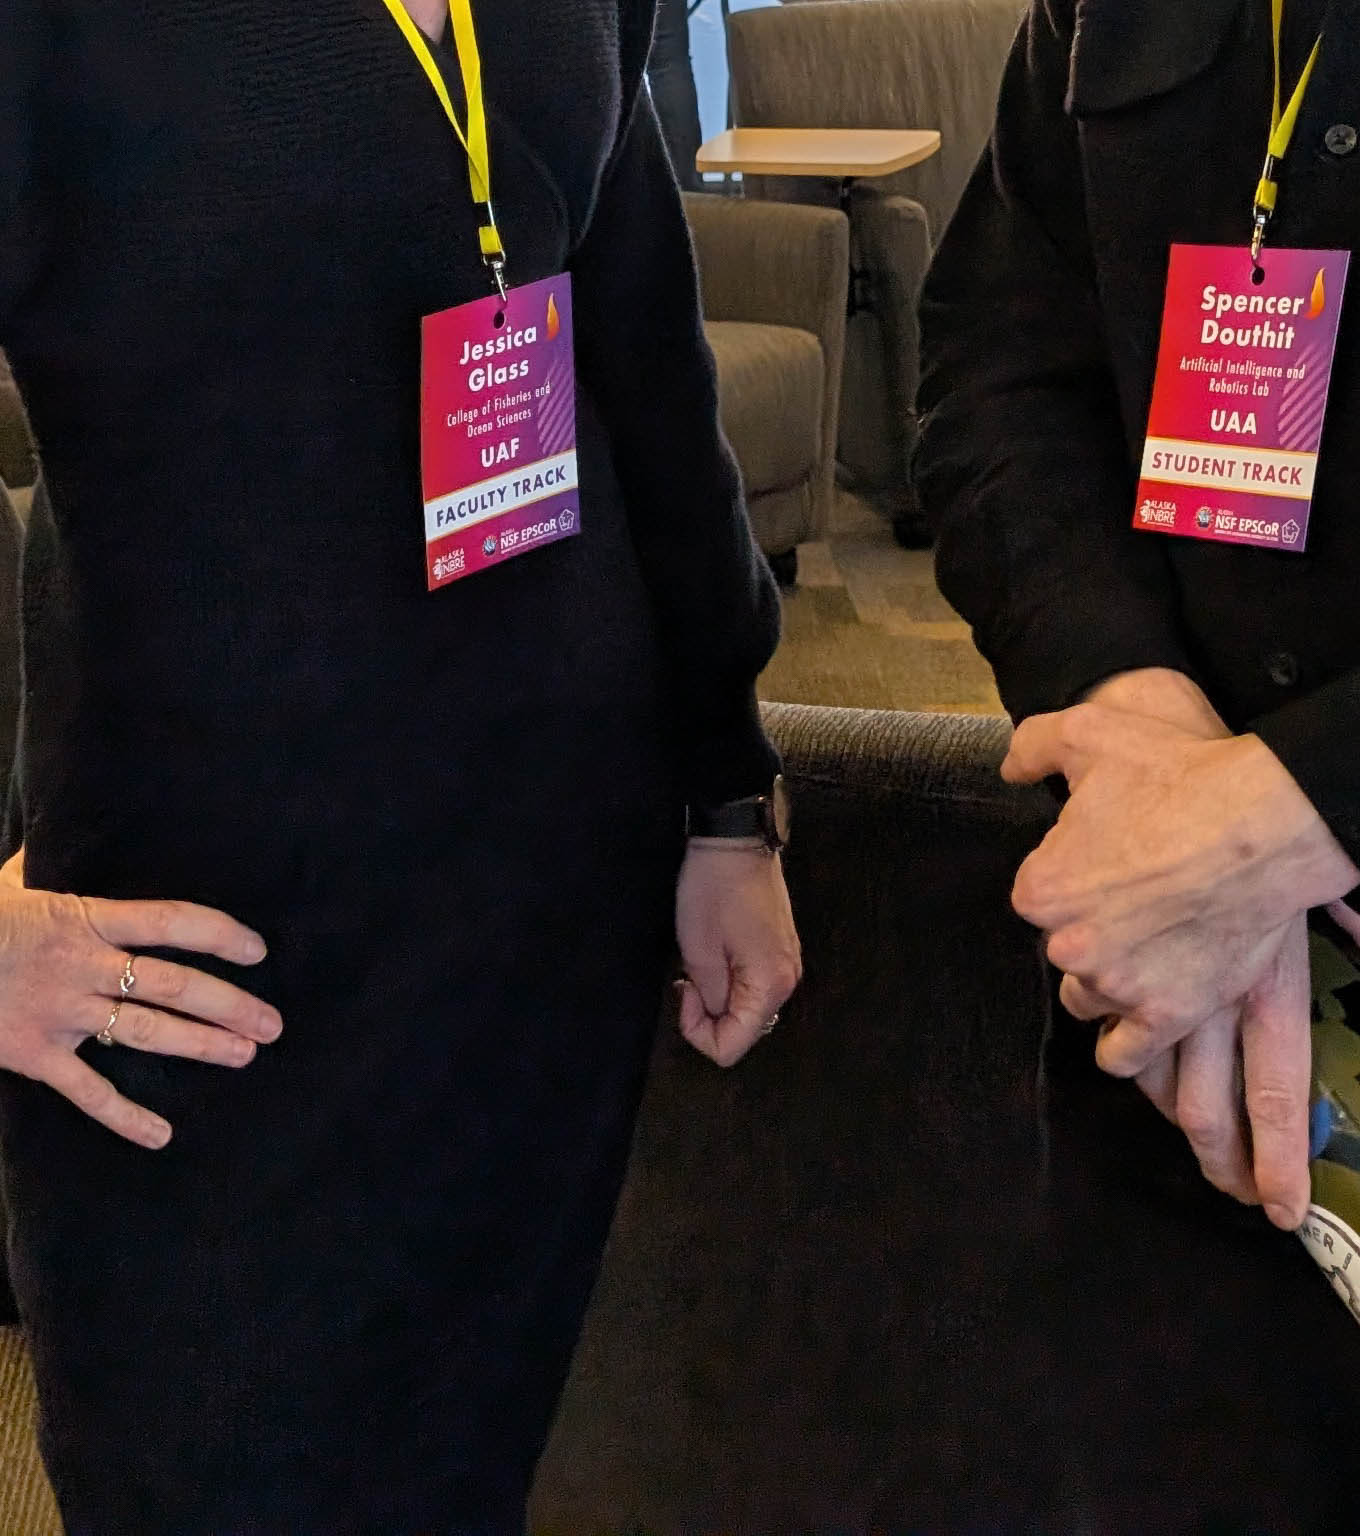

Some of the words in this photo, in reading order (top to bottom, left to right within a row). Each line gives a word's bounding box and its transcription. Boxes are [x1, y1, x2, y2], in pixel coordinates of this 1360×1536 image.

[1200, 285, 1305, 319] Spencer
[459, 326, 537, 365] Jessica
[1200, 319, 1295, 349] Douthit
[468, 359, 529, 392] Glass
[1179, 356, 1224, 373] Artificial
[1226, 359, 1283, 379] Intelligence
[1286, 363, 1306, 379] and
[1208, 377, 1249, 395] Robotics
[1252, 380, 1269, 397] Lab
[447, 408, 479, 427] College
[481, 399, 491, 416] of
[494, 390, 532, 412] Fisheries
[535, 381, 551, 398] and
[467, 421, 493, 438] Ocean
[496, 408, 532, 429] Sciences
[1210, 409, 1257, 435] UAA
[481, 437, 520, 468] UAF
[1151, 451, 1237, 478] STUDENT
[1242, 461, 1303, 485] TRACK
[436, 485, 507, 527] FACULTY
[512, 465, 566, 498] TRACK
[500, 533, 521, 550] NSF
[521, 518, 558, 541] EPSCoR
[1215, 515, 1238, 531] NSF
[1239, 518, 1280, 537] EPSCoR
